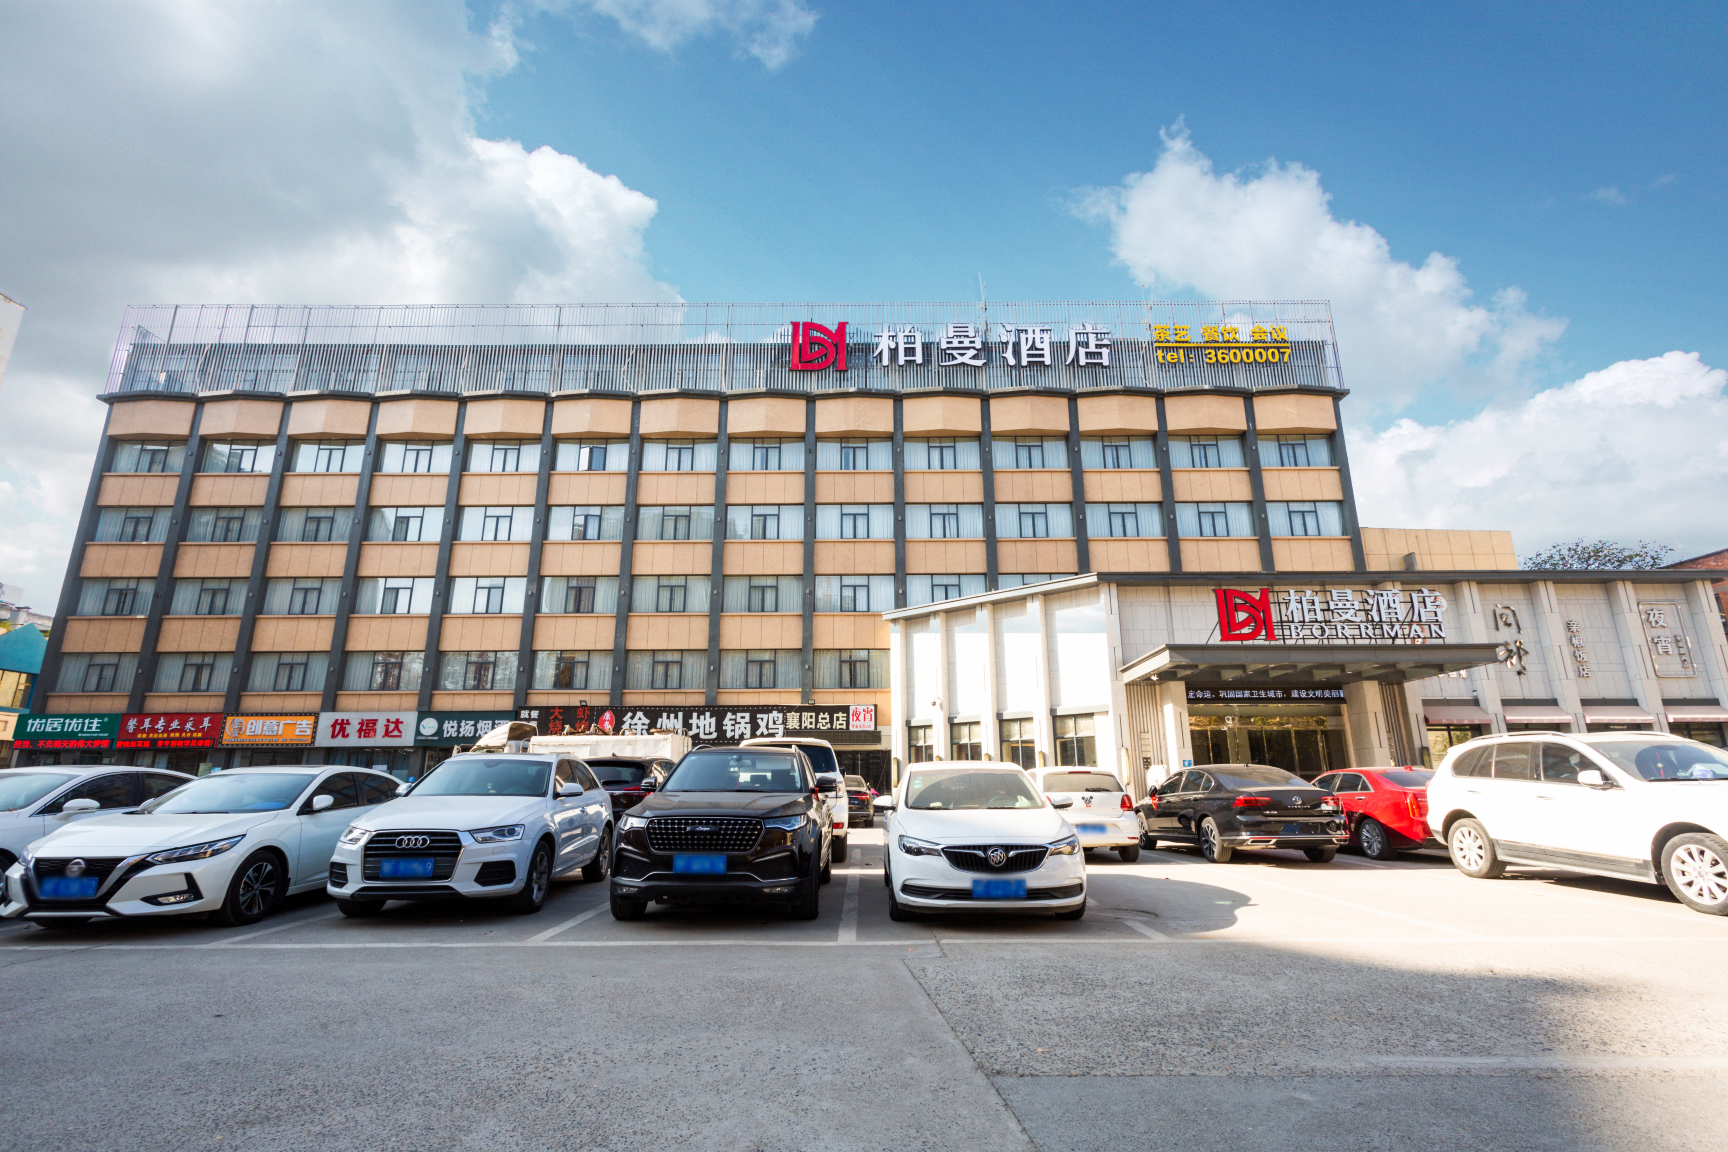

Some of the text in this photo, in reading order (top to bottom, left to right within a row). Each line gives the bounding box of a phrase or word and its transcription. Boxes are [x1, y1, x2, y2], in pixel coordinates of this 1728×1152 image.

[1153, 324, 1289, 341] 茶艺 餐饮 会议
[873, 321, 1112, 368] 柏曼酒店
[1205, 348, 1291, 363] 3600007
[1283, 588, 1443, 622] 柏曼酒店
[1288, 623, 1447, 638] BORRMAN
[1646, 608, 1673, 655] 夜宵
[786, 711, 847, 730] 襄阳总店
[851, 706, 873, 722] 夜宵
[26, 717, 103, 733] 优居优住
[245, 719, 313, 736] 创意广告
[330, 717, 404, 739] 优福达
[622, 711, 786, 740] 徐州地锅鸡
